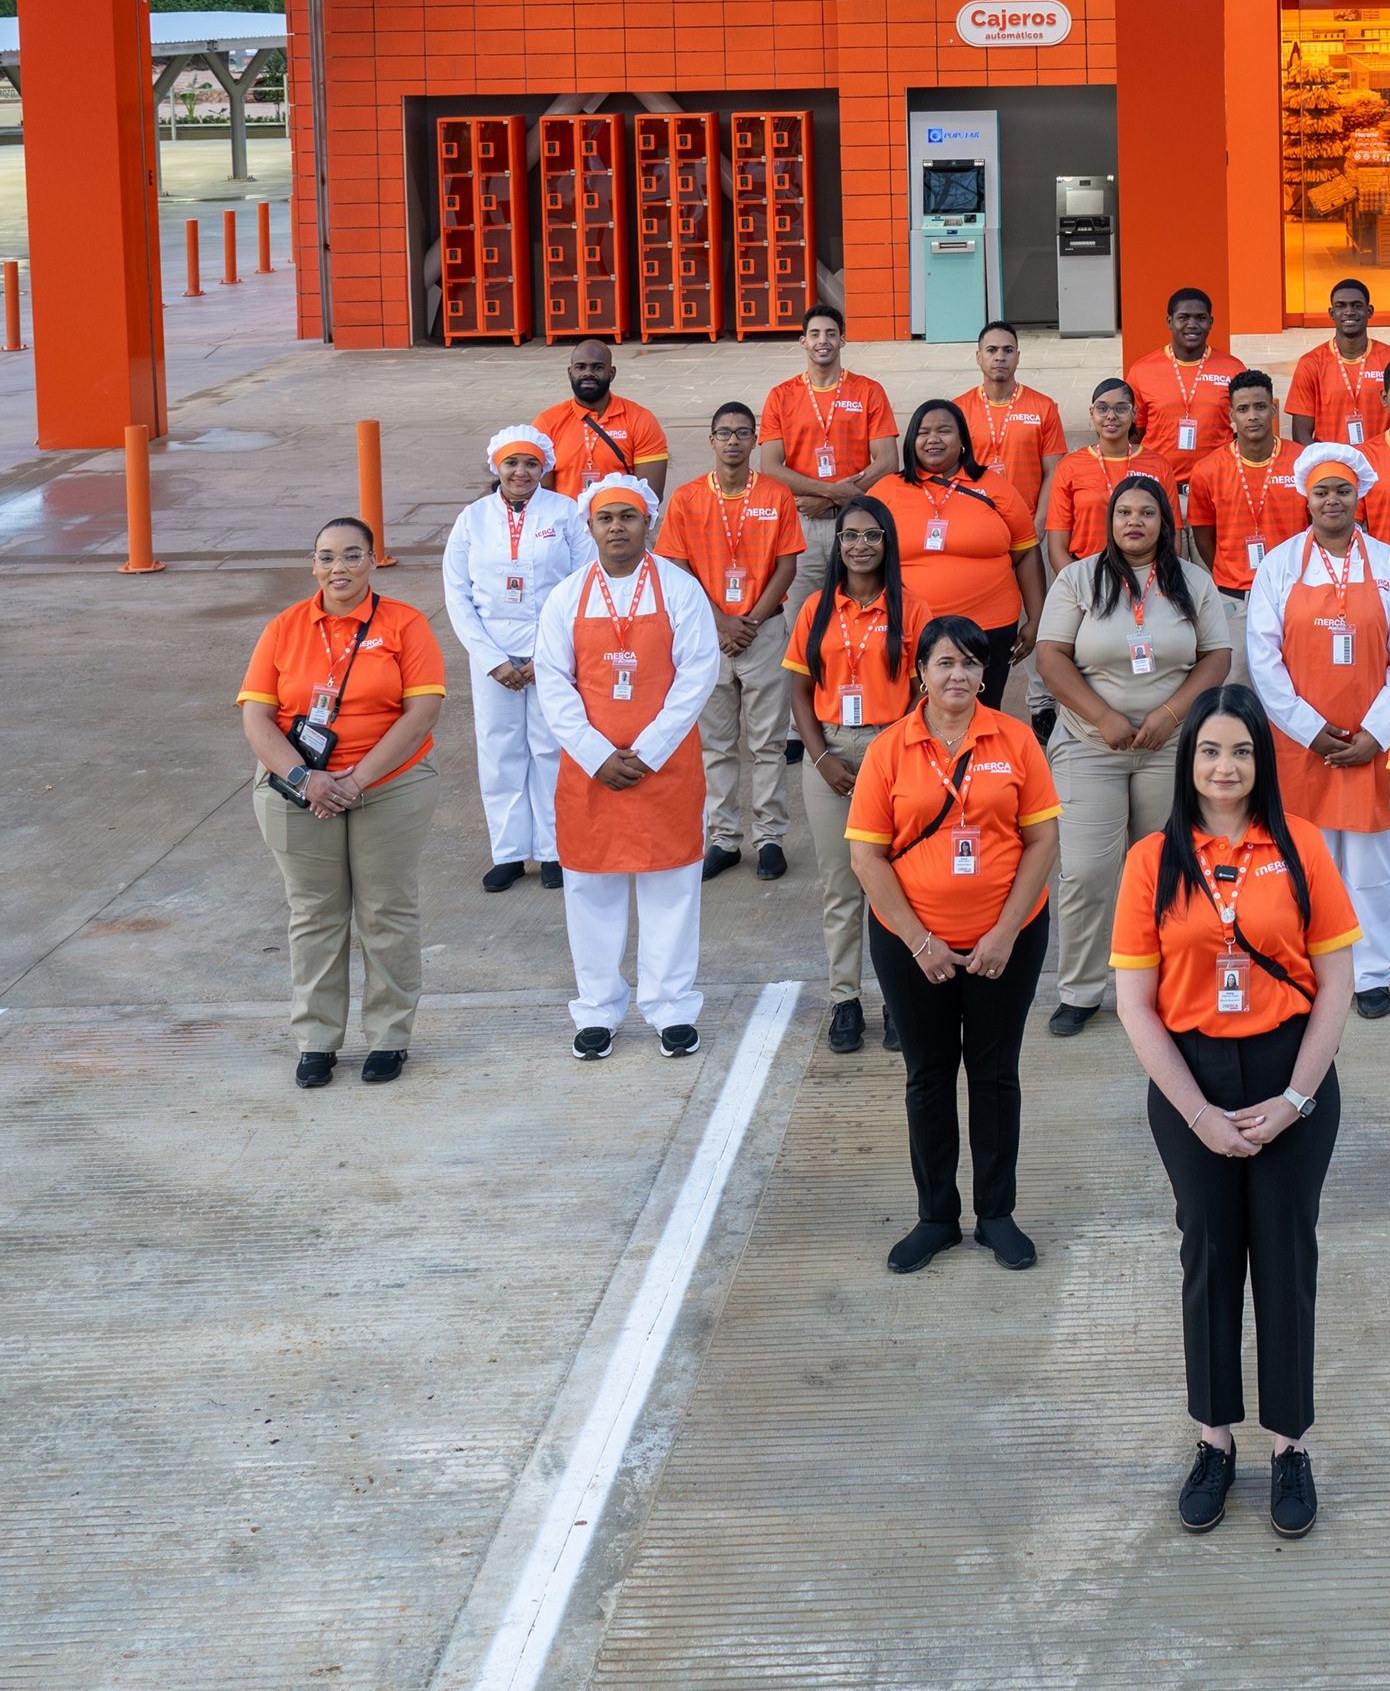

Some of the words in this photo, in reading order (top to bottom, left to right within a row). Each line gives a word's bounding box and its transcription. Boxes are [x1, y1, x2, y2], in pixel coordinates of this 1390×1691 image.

[970, 9, 1057, 30] Cajeros
[984, 30, 1044, 41] automáticos
[1365, 371, 1384, 379] MERC
[1271, 475, 1295, 484] MERC
